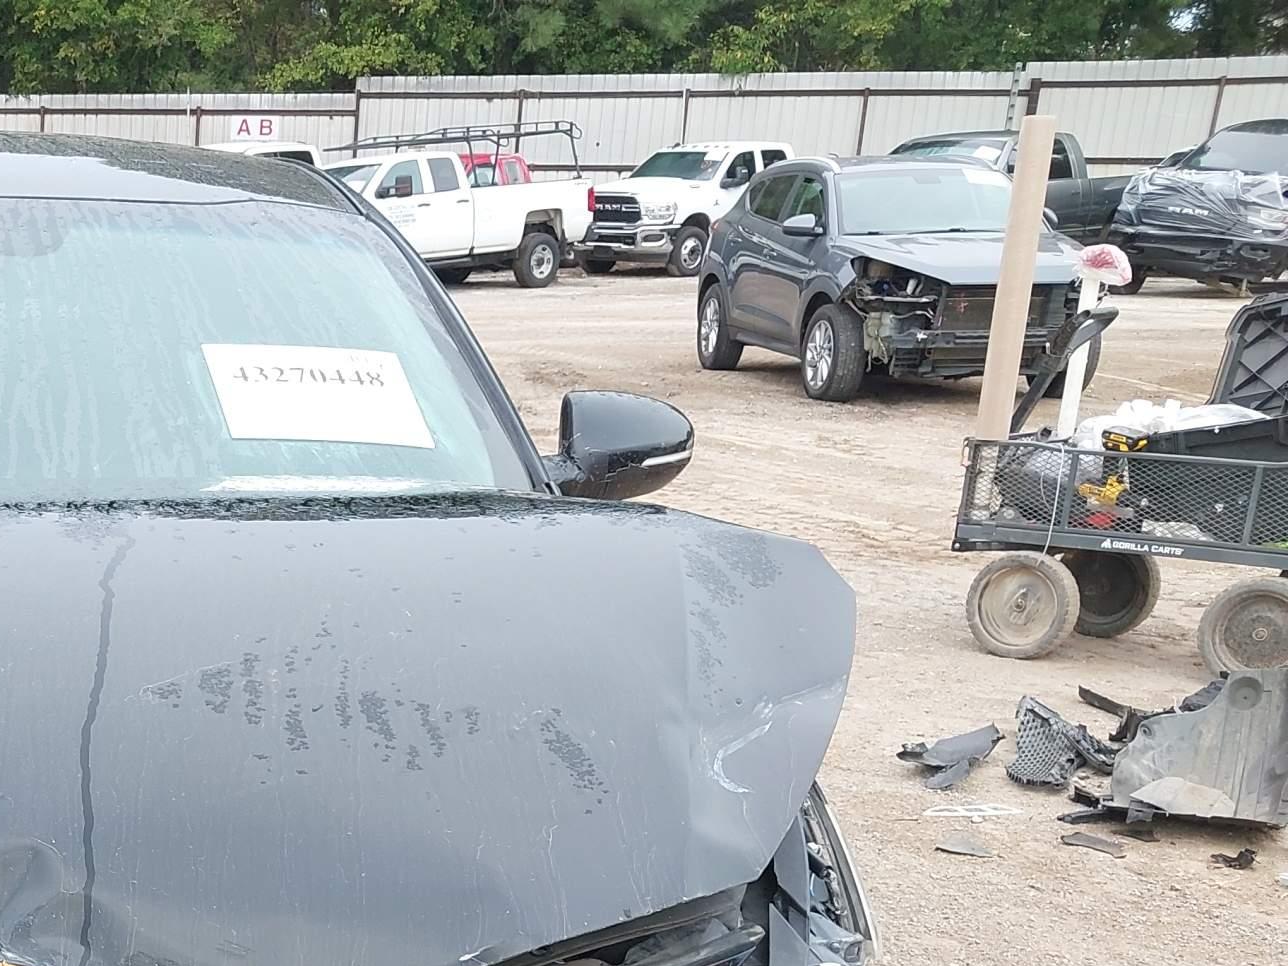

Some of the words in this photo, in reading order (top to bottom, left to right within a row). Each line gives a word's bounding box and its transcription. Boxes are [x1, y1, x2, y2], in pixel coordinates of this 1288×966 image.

[237, 118, 251, 136] A
[259, 119, 273, 136] B
[1167, 206, 1210, 217] RAM
[232, 365, 386, 388] 43270448
[1112, 540, 1150, 552] GORILLA
[1150, 544, 1184, 556] CARTS
